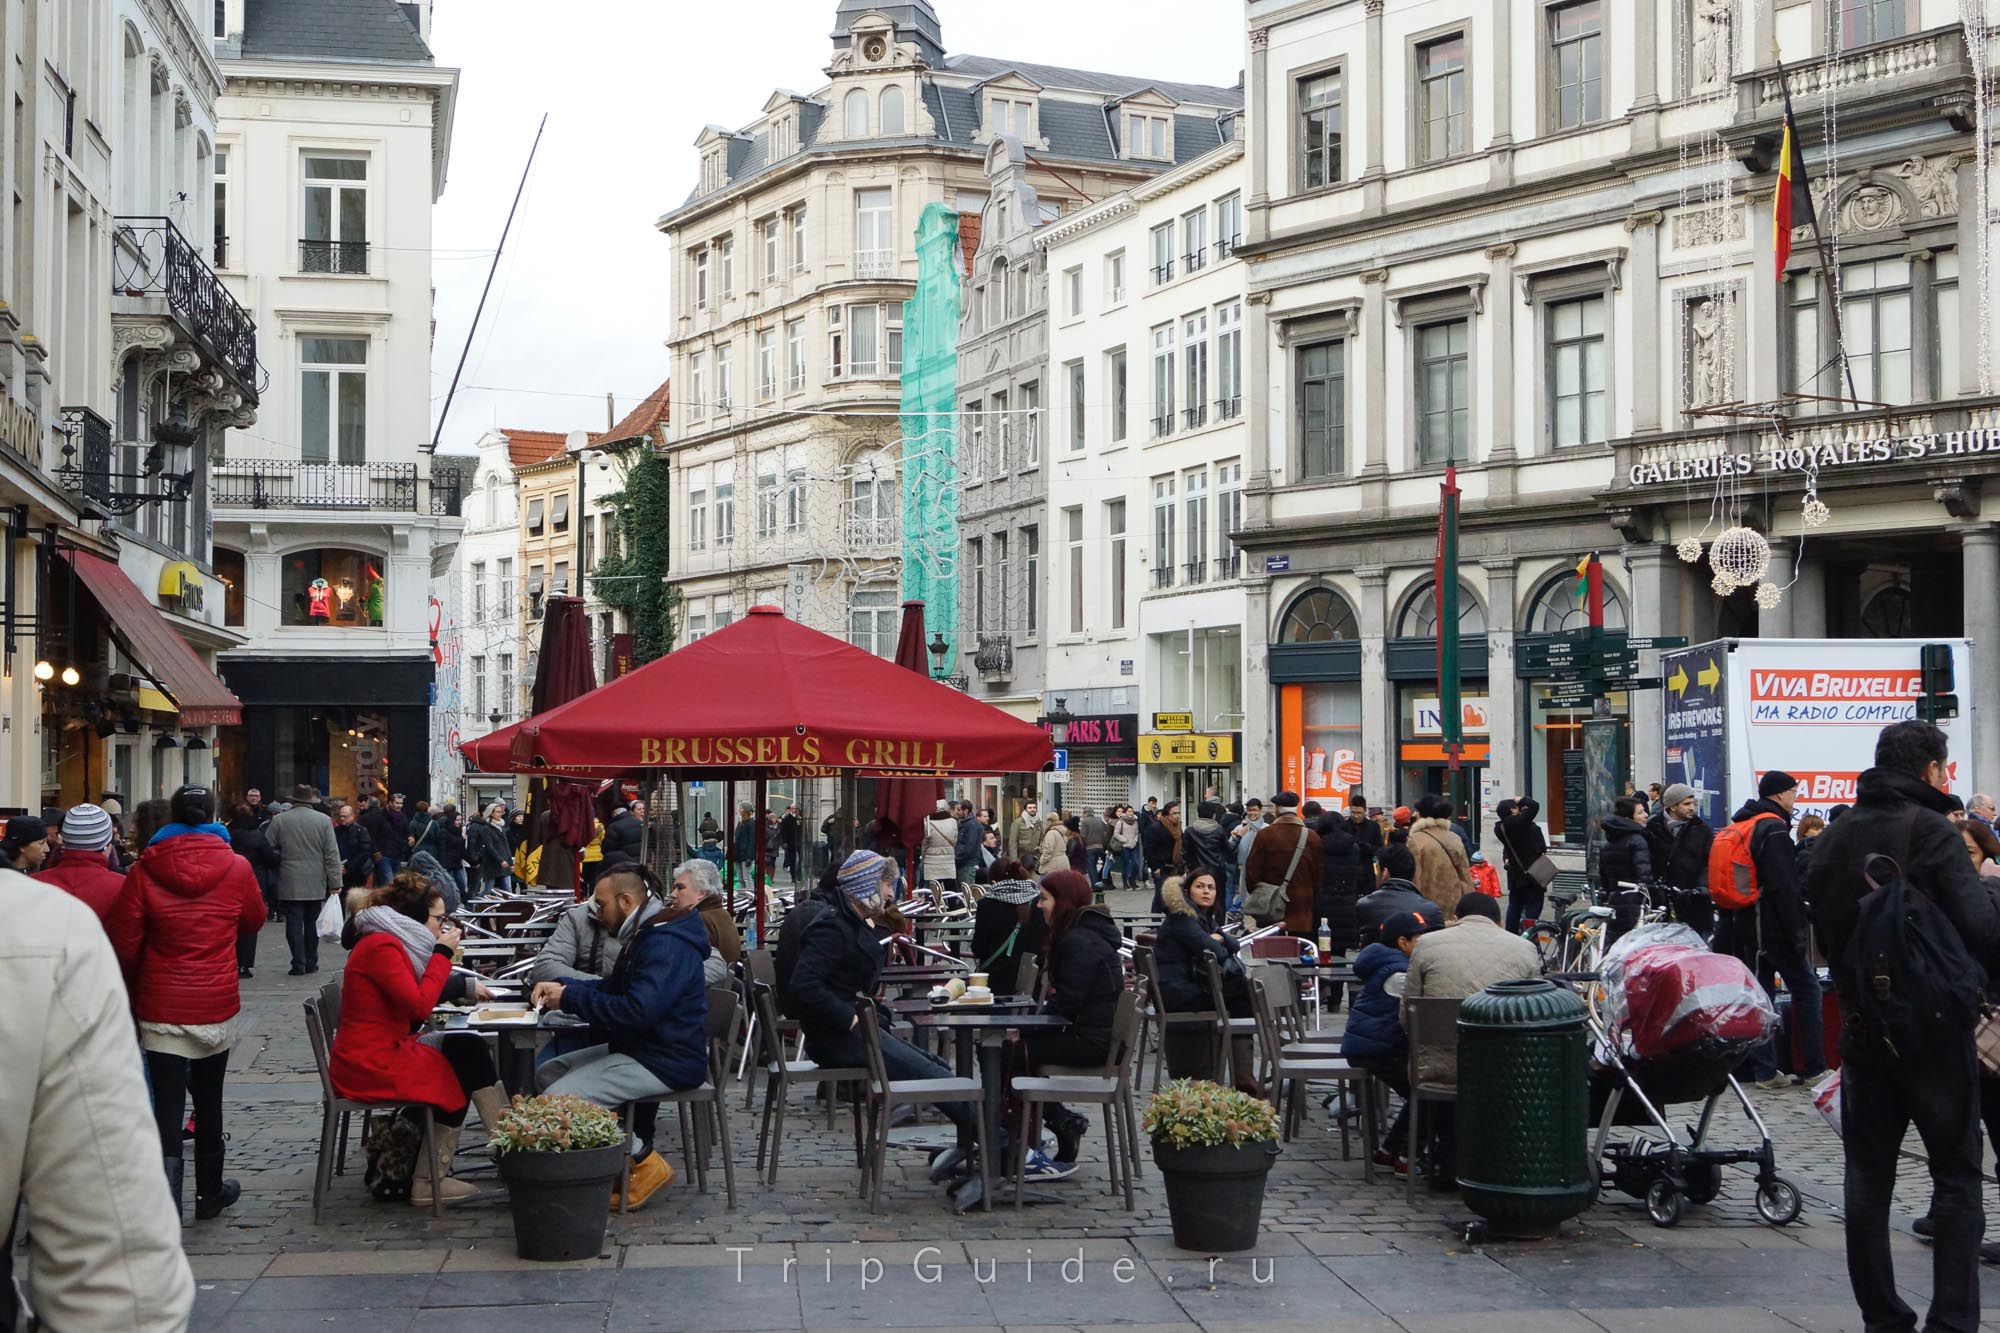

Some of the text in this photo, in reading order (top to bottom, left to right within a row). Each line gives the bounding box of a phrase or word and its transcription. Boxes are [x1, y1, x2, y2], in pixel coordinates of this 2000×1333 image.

[1629, 452, 1752, 485] GALERIES
[1770, 438, 1892, 472] ROYALES
[1419, 710, 1442, 728] IN
[1682, 706, 1722, 728] FIREWORKS
[1755, 704, 1915, 721] MA RADIO COMPLIC
[1065, 720, 1101, 743] PARIS
[1105, 719, 1121, 743] XL
[640, 736, 955, 769] BRUSSELS GRILL
